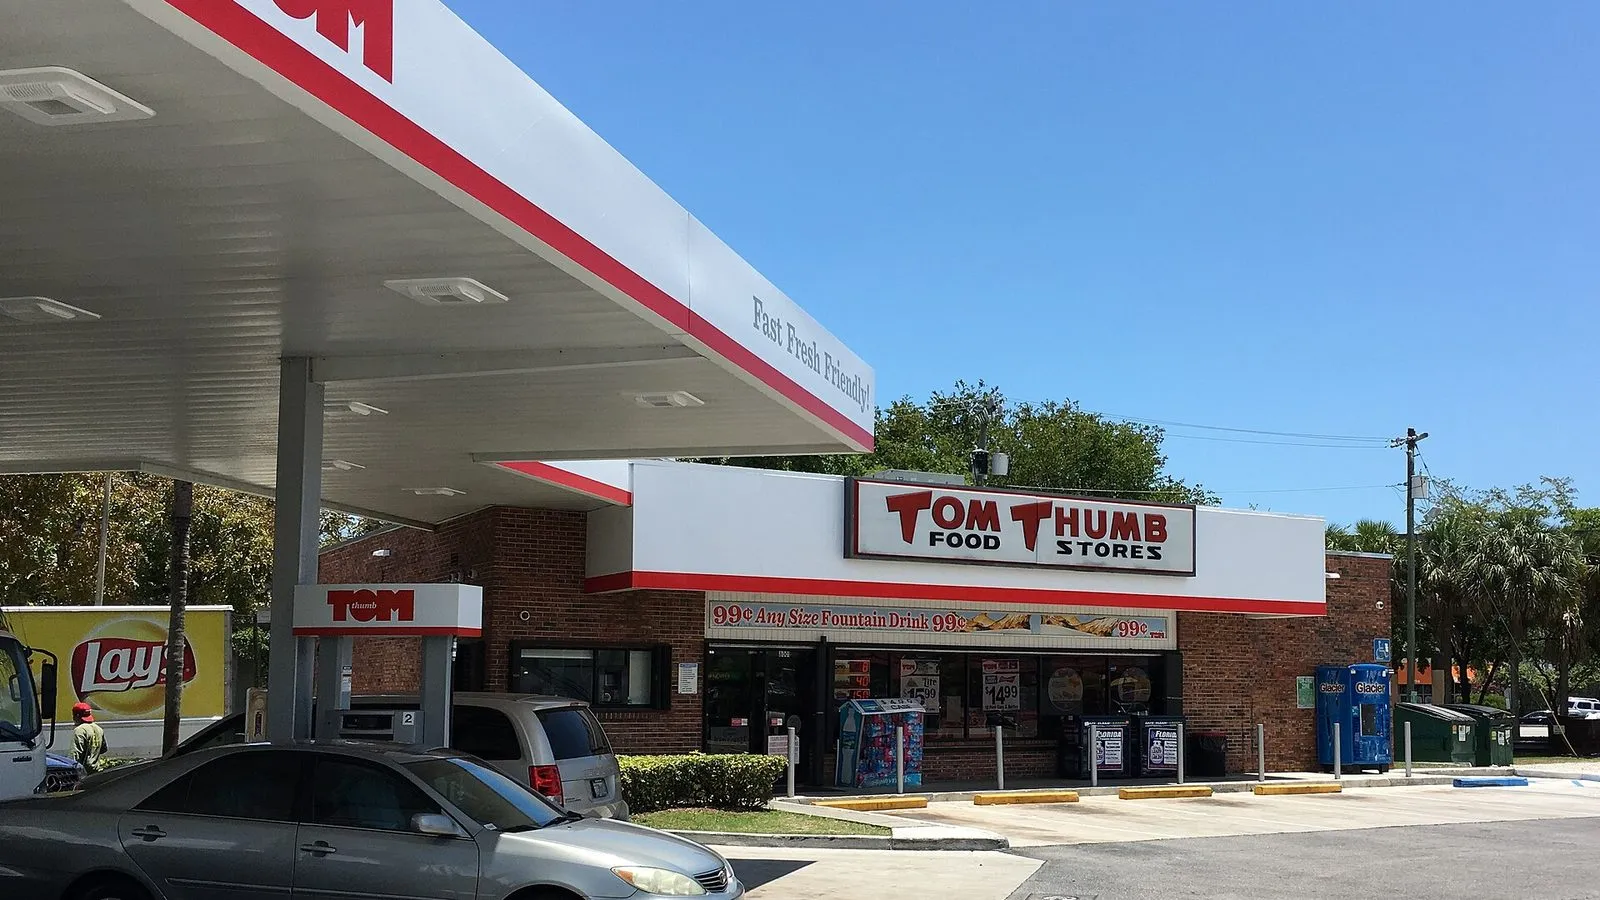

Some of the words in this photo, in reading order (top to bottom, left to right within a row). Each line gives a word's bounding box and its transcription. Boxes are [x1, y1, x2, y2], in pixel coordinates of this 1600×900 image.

[753, 296, 782, 346] Fast
[787, 322, 820, 374] Fresh
[824, 352, 869, 413] Friendly!
[886, 490, 1001, 544] TOM
[1010, 501, 1168, 552] THUMB
[929, 532, 1001, 550] FOOD
[1056, 540, 1162, 561] STORES
[327, 589, 415, 622] TOM
[351, 601, 377, 610] thumb
[713, 605, 753, 625] 99¢
[755, 607, 786, 628] Any
[788, 608, 819, 626] Size
[821, 610, 887, 628] Fountain
[888, 612, 929, 629] Drink
[932, 613, 967, 632] 99¢
[1118, 620, 1148, 637] 99¢
[80, 641, 170, 693] Lay
[856, 675, 869, 687] 40
[1320, 683, 1345, 693] Glacier
[1356, 682, 1385, 694] Glacier
[404, 713, 412, 723] 2
